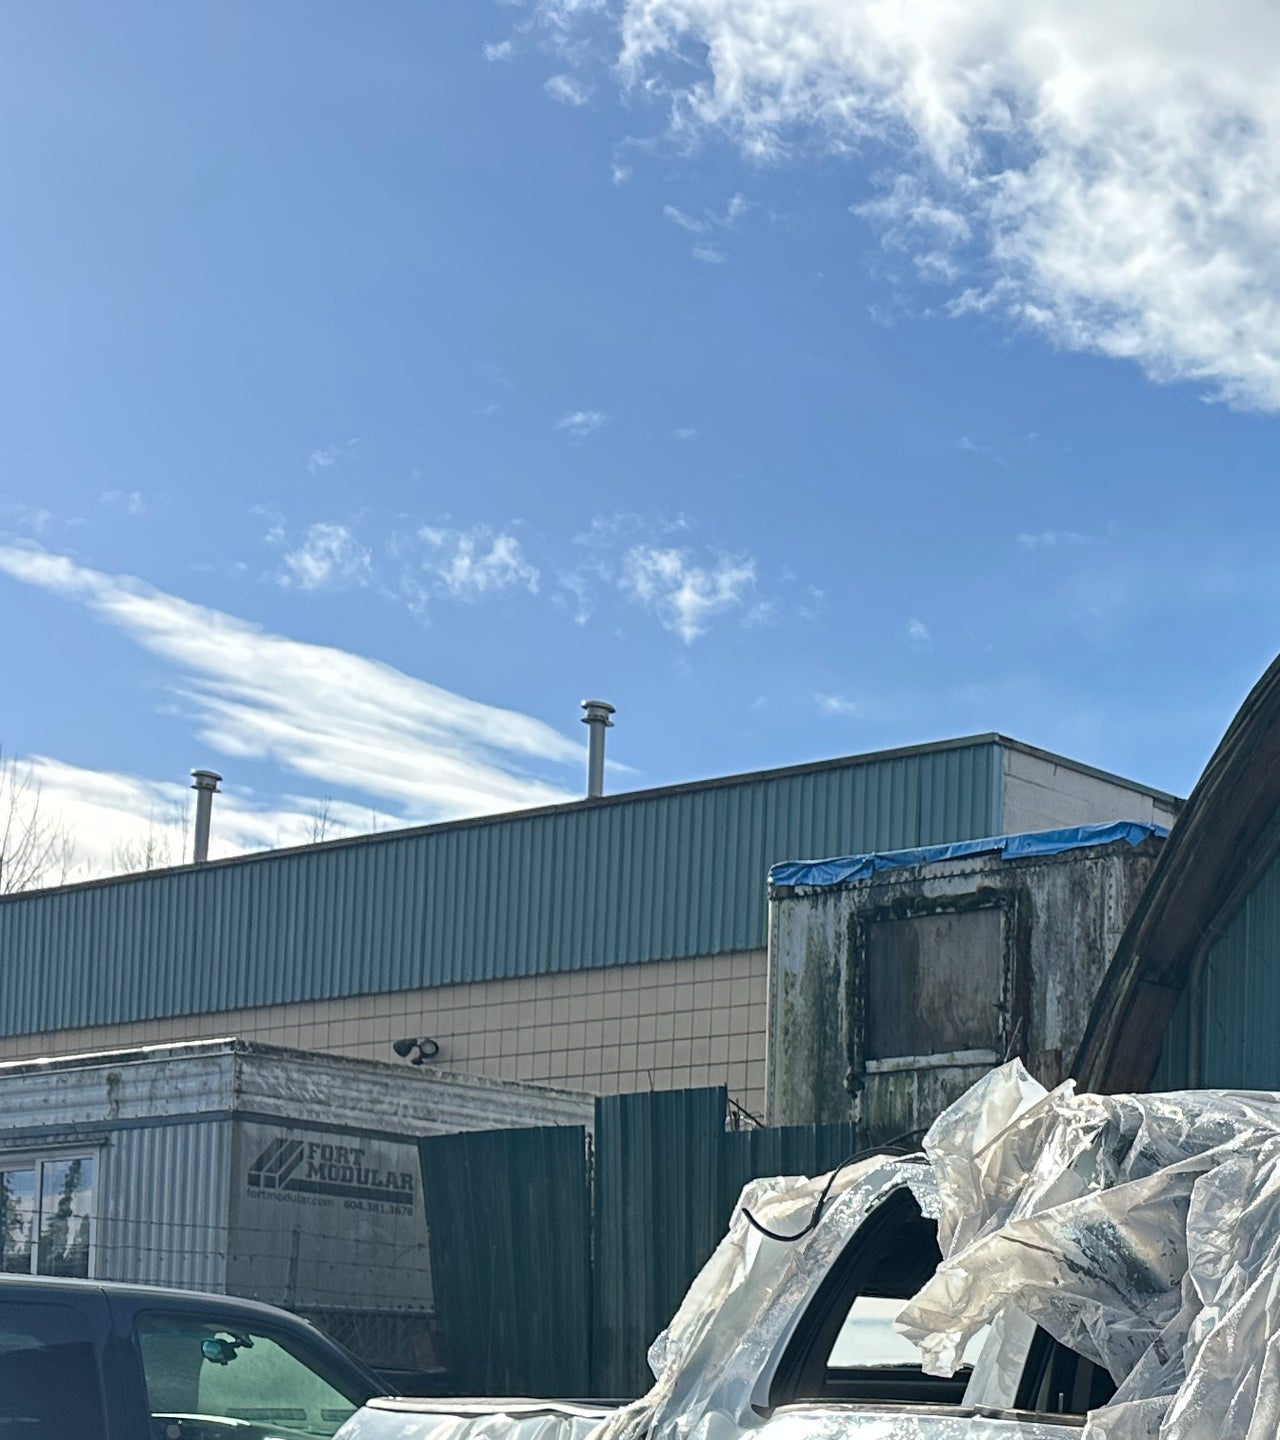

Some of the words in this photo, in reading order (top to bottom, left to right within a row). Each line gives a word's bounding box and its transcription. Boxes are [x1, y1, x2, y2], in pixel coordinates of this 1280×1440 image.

[307, 1142, 365, 1166] FORT
[305, 1160, 414, 1192] MODULAR
[246, 1188, 335, 1208] fortmodular.com
